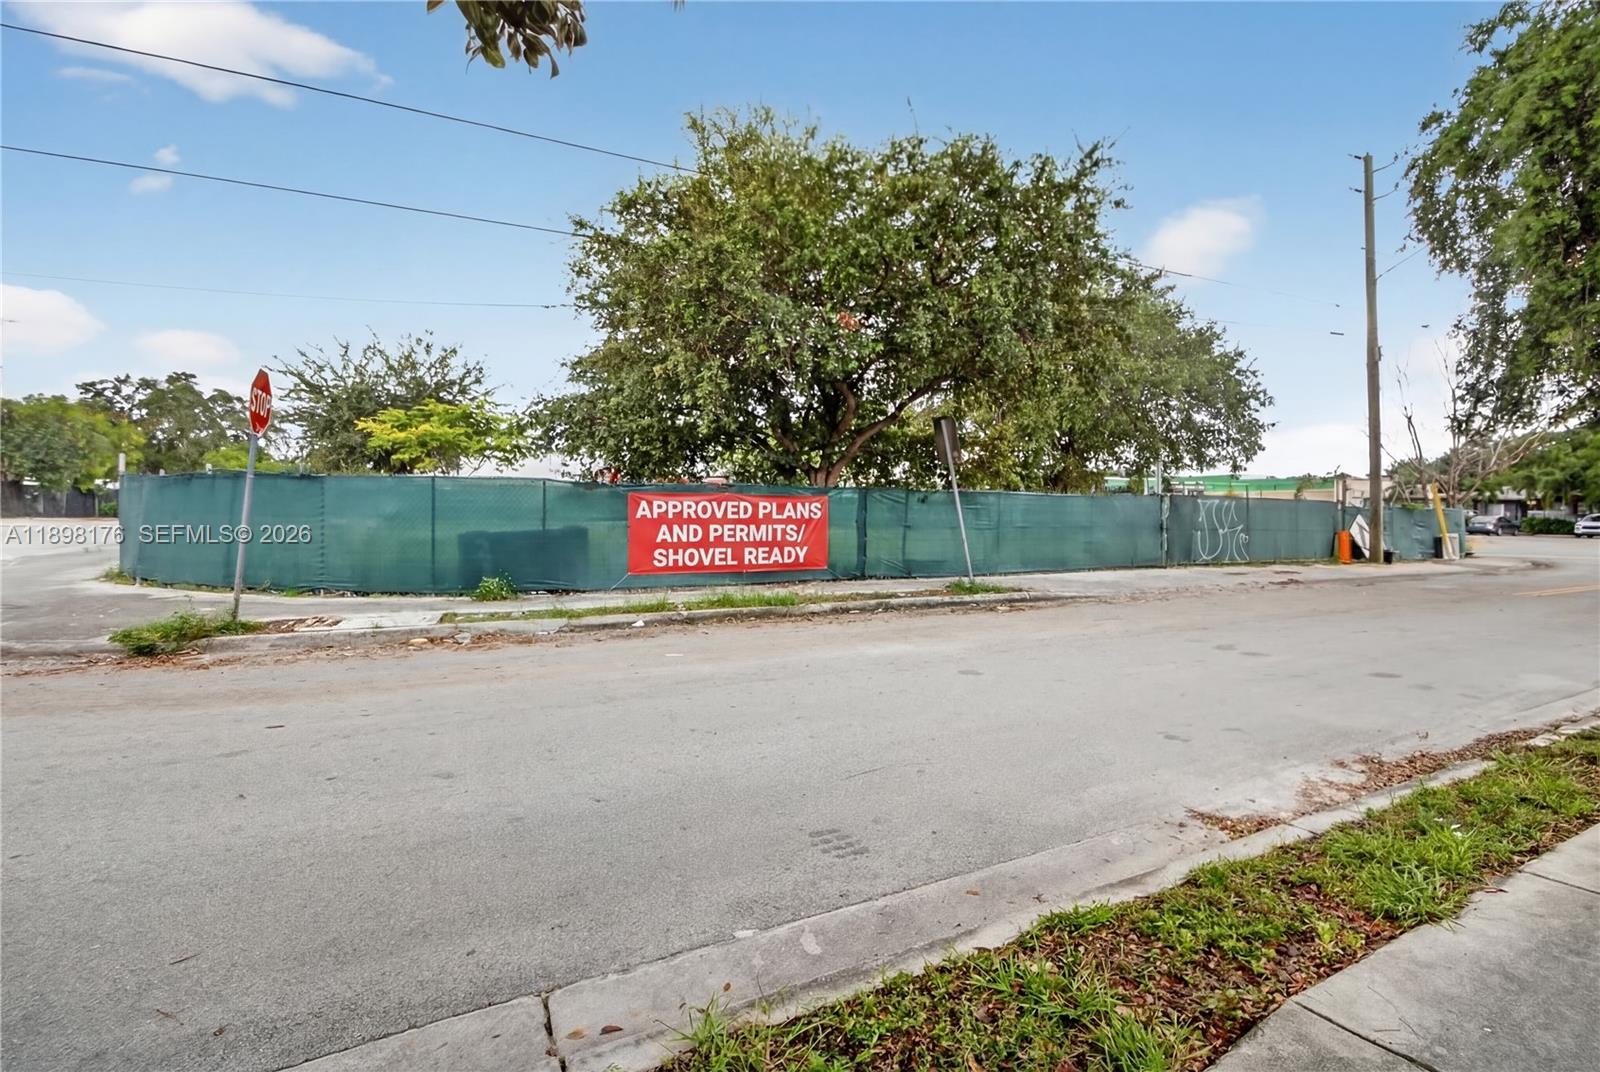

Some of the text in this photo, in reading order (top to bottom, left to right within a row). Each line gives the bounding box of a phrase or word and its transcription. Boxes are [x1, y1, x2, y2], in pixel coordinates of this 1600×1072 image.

[251, 387, 271, 418] STOP
[635, 500, 822, 519] APPROVED PLANS
[656, 523, 806, 543] AND PERMITS/
[653, 546, 808, 567] SHOVEL READY
